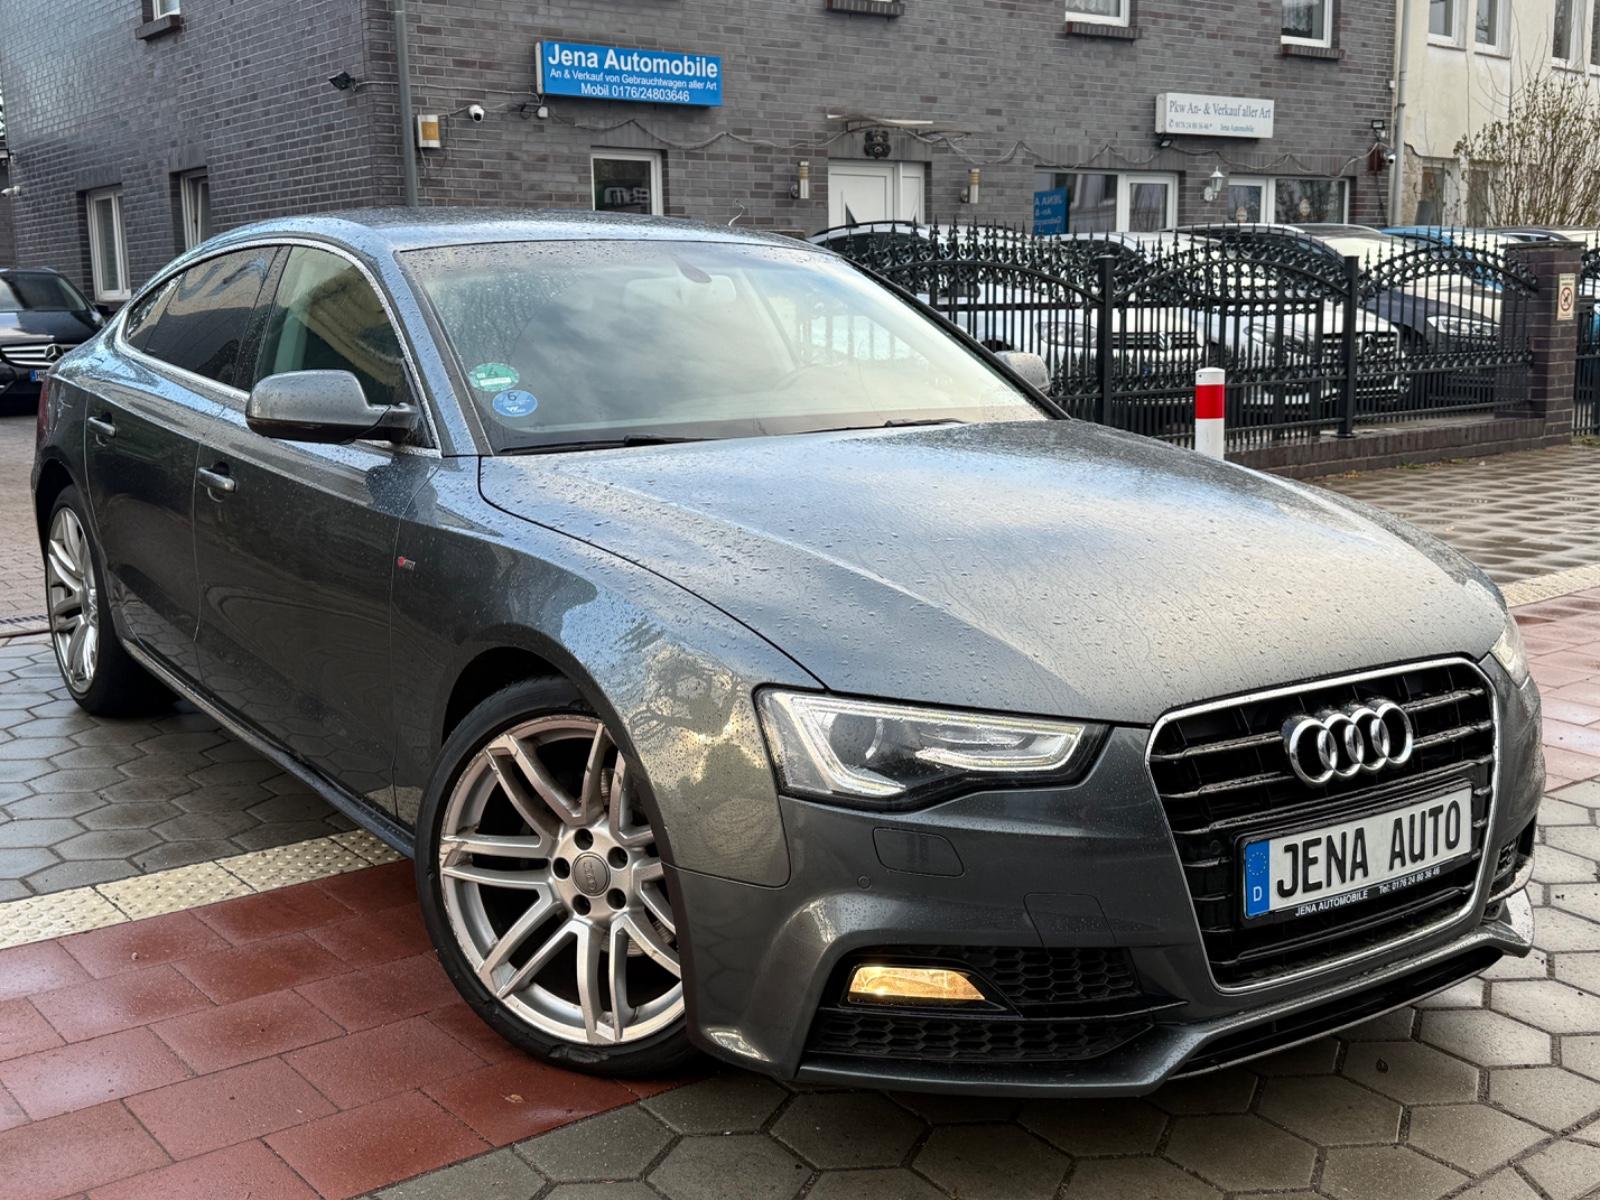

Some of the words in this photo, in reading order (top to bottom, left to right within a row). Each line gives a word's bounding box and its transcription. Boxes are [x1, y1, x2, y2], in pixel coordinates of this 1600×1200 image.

[548, 43, 598, 68] Jena
[604, 49, 718, 78] Automobile
[550, 68, 562, 78] An
[563, 69, 571, 79] &
[572, 70, 604, 82] Verkauf
[605, 73, 620, 83] von
[621, 73, 687, 89] Gebrauchtwagen
[688, 79, 704, 89] aller
[705, 80, 717, 91] Art
[581, 82, 609, 96] Mobil
[612, 84, 690, 102] 0176/24803646
[1169, 100, 1186, 113] Pkw
[1187, 102, 1202, 114] An-
[1203, 103, 1211, 116] &
[1212, 103, 1241, 117] Verkauf
[1242, 104, 1258, 118] aller
[1258, 107, 1271, 119] Art
[1277, 827, 1369, 898] JENA
[1389, 800, 1461, 871] AUTO
[1392, 879, 1407, 890] 0176
[1408, 875, 1415, 885] 24
[1253, 886, 1263, 902] D
[1295, 903, 1317, 917] JENA
[1318, 890, 1368, 911] AUTOMOBILE
